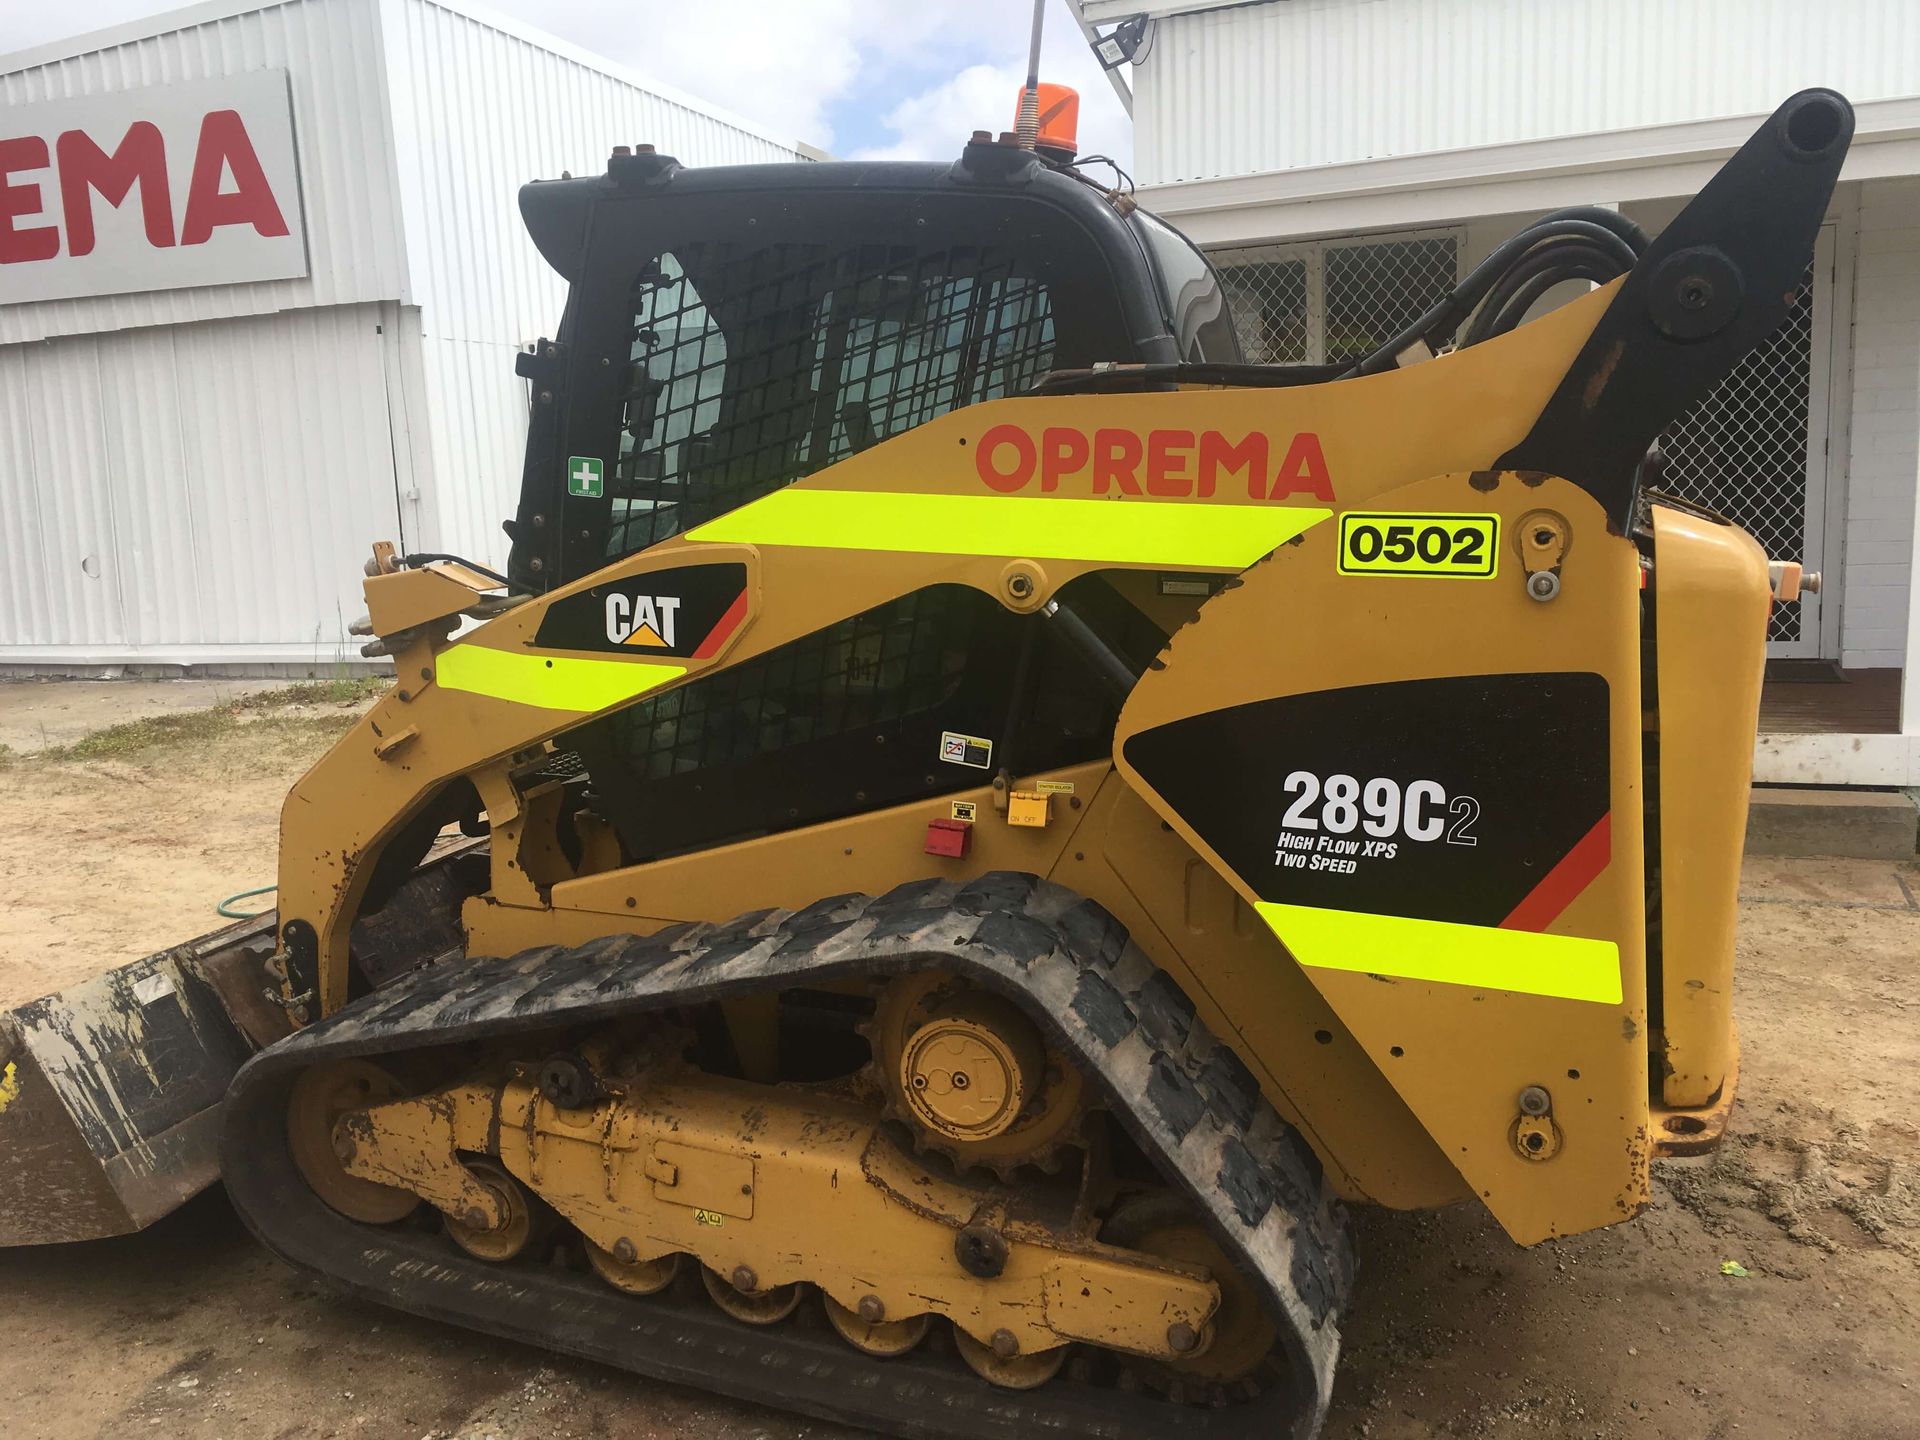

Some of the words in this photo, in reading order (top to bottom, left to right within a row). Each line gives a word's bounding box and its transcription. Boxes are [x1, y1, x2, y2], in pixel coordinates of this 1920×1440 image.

[975, 423, 1336, 502] OPREMA
[1349, 525, 1485, 565] 0502
[605, 592, 681, 648] CAT
[1281, 770, 1481, 847] 289C2
[1274, 850, 1306, 869] TWO
[1308, 854, 1358, 875] SPEED
[1276, 831, 1315, 850] HIGH
[1316, 836, 1361, 855] FLOW
[1361, 840, 1398, 859] XPS
